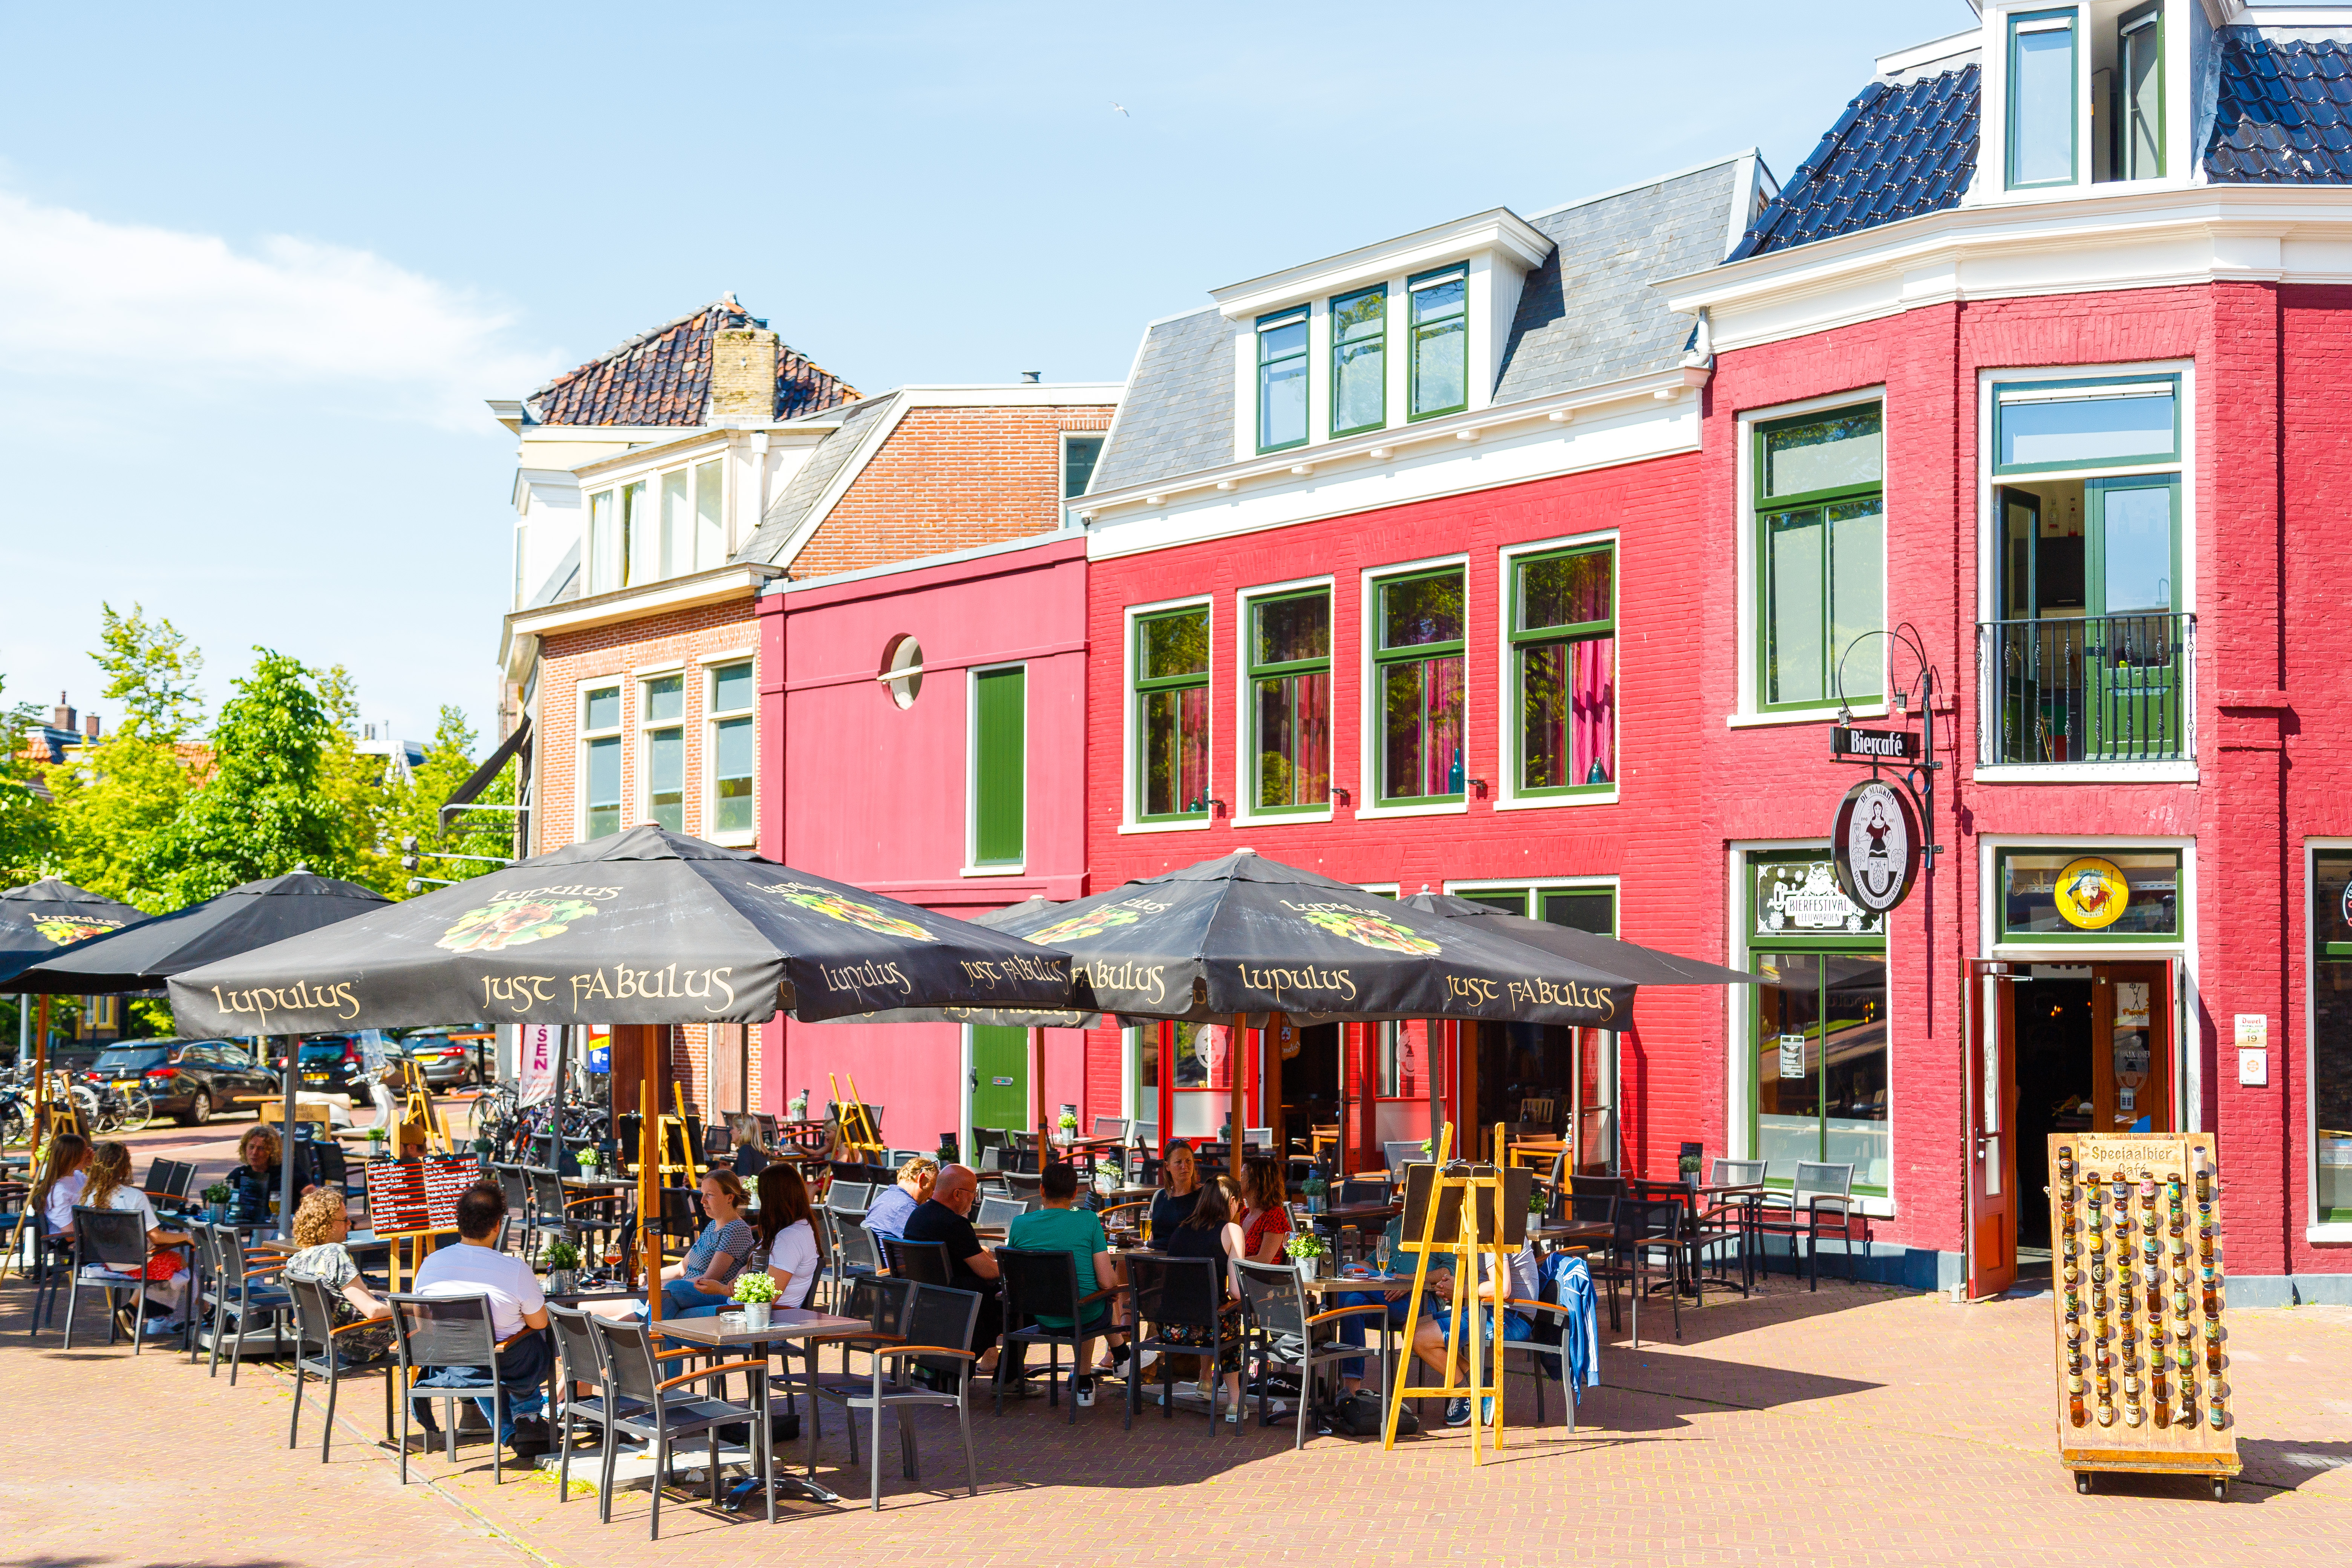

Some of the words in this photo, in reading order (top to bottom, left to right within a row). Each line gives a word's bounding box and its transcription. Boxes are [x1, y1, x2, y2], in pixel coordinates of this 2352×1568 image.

[1851, 730, 1903, 756] Biercafé
[1860, 792, 1869, 803] DE
[1869, 786, 1896, 805] MARKIES
[1854, 870, 1873, 905] SPECIAALBIER
[1790, 899, 1848, 911] BIERFESTIVAL
[1798, 913, 1839, 922] LEEUWARDEN
[533, 1024, 548, 1070] SEN
[2092, 1146, 2173, 1162] Speciaalbier
